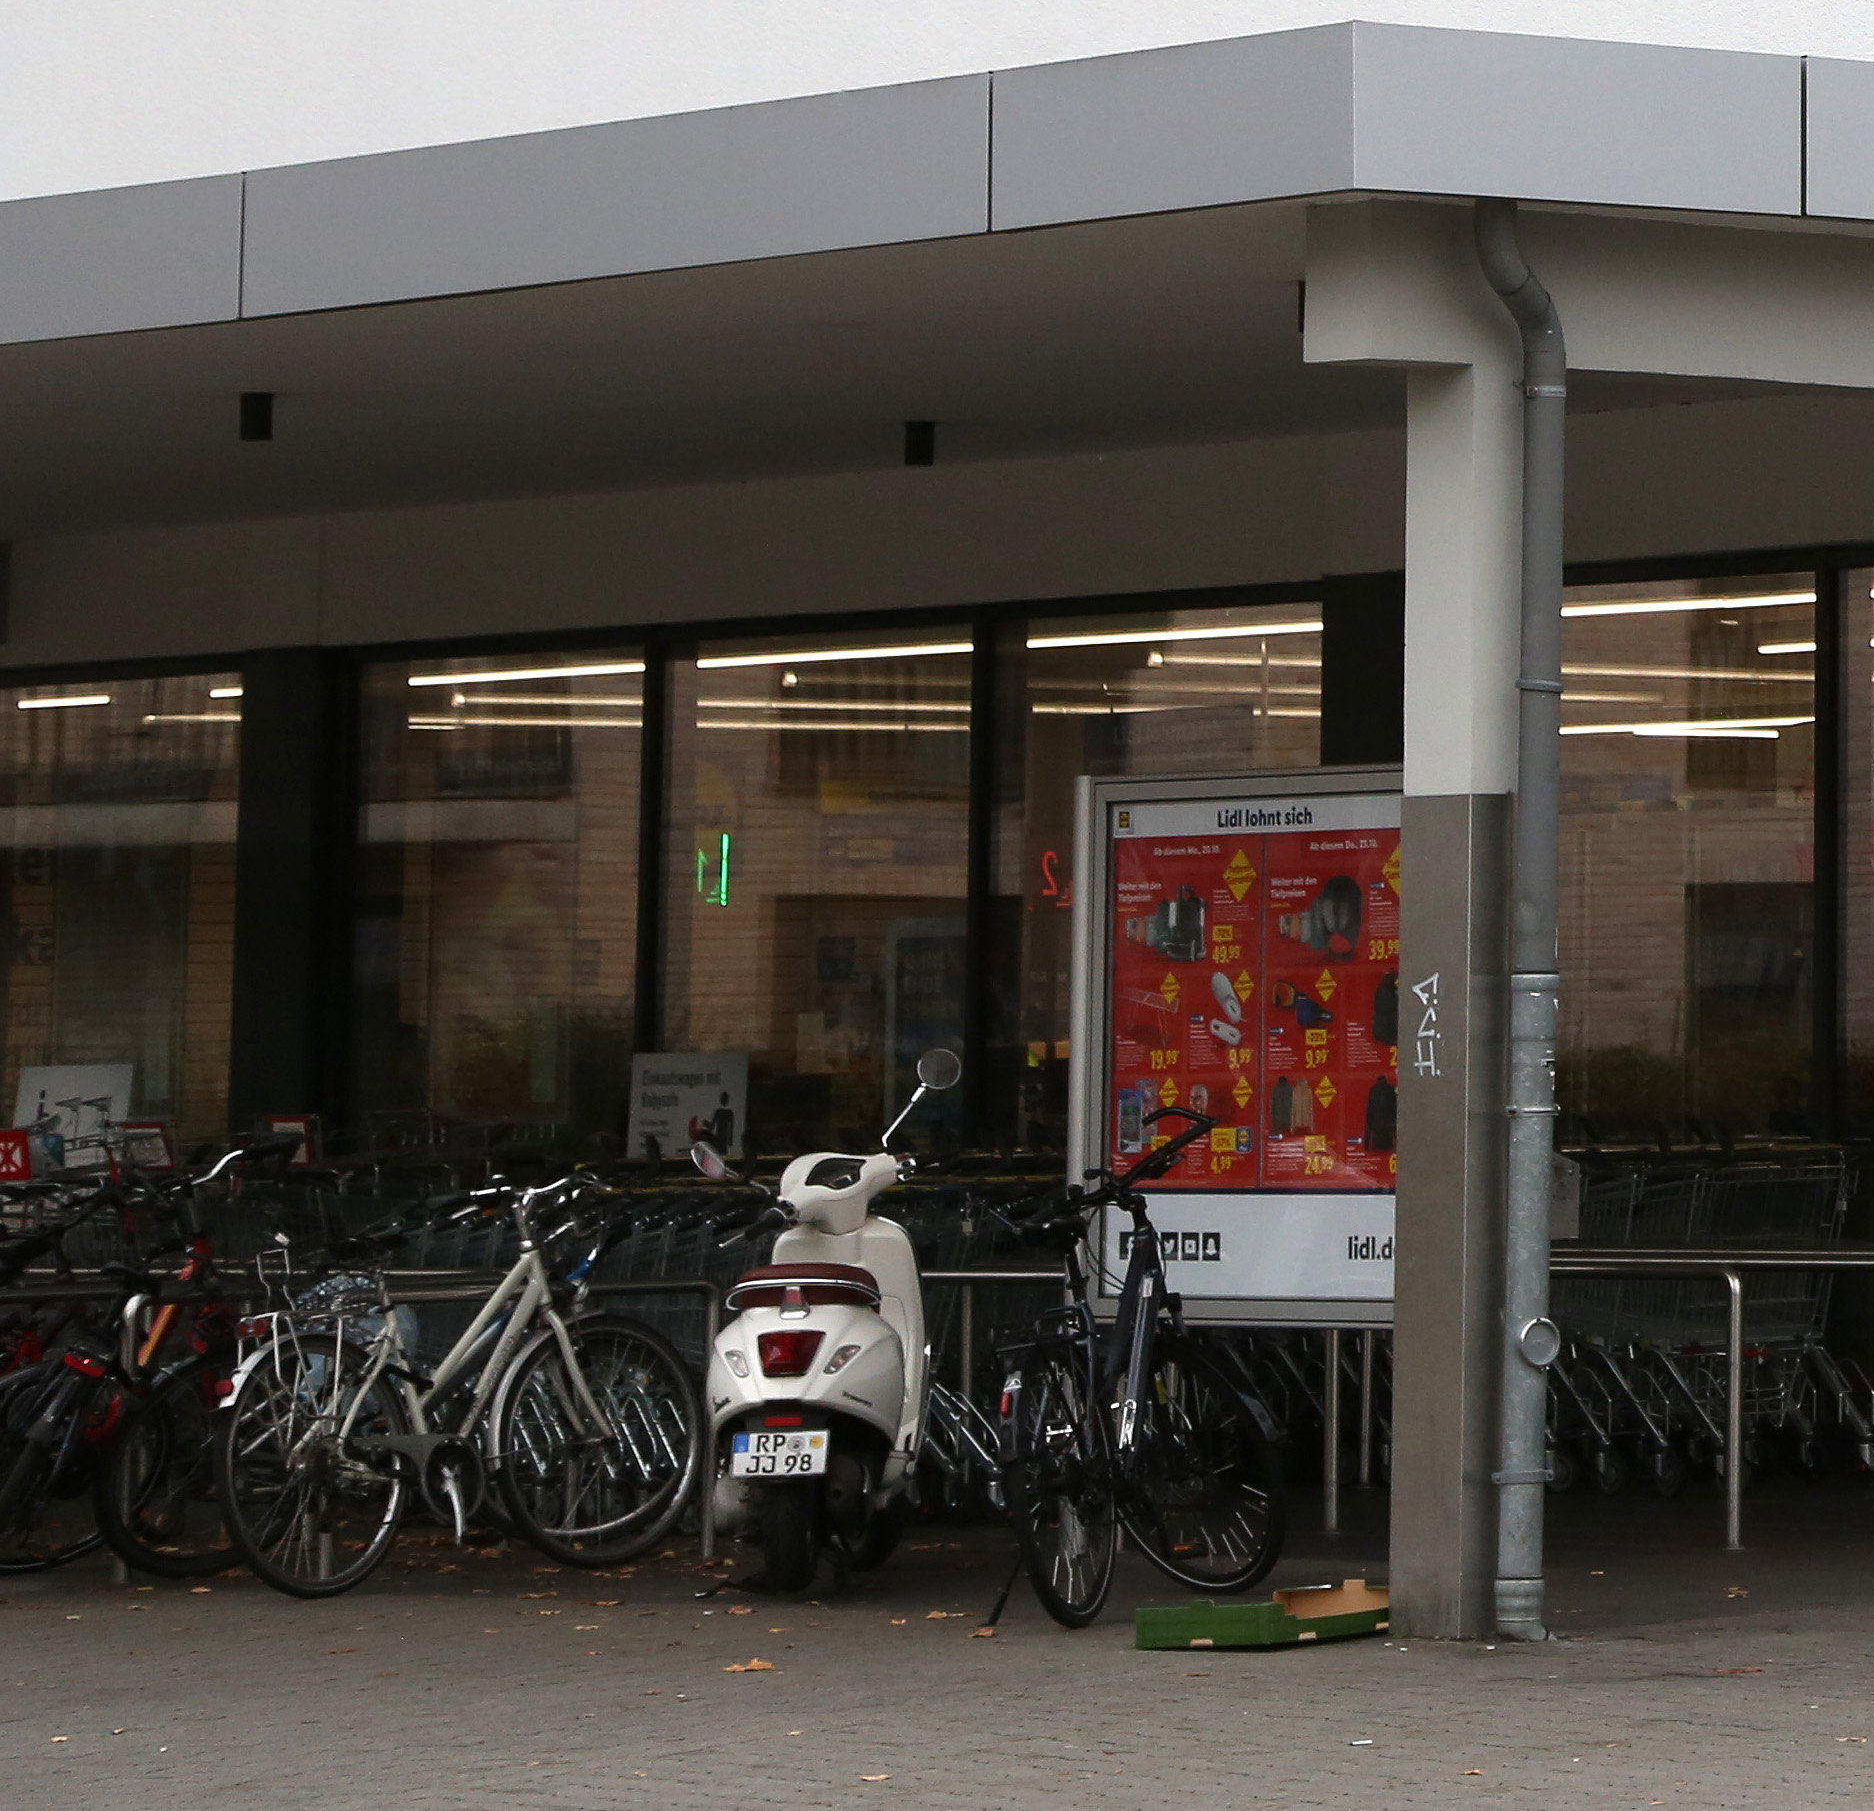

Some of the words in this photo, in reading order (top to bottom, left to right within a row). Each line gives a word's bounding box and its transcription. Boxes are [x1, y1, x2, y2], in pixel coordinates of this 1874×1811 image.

[1217, 809, 1242, 828] Lidl
[1245, 808, 1282, 827] lohnt
[1284, 806, 1313, 825] sich
[1348, 1235, 1395, 1260] lidl.d
[756, 1435, 786, 1453] RP
[746, 1455, 777, 1474] JJ
[785, 1454, 812, 1474] 98
